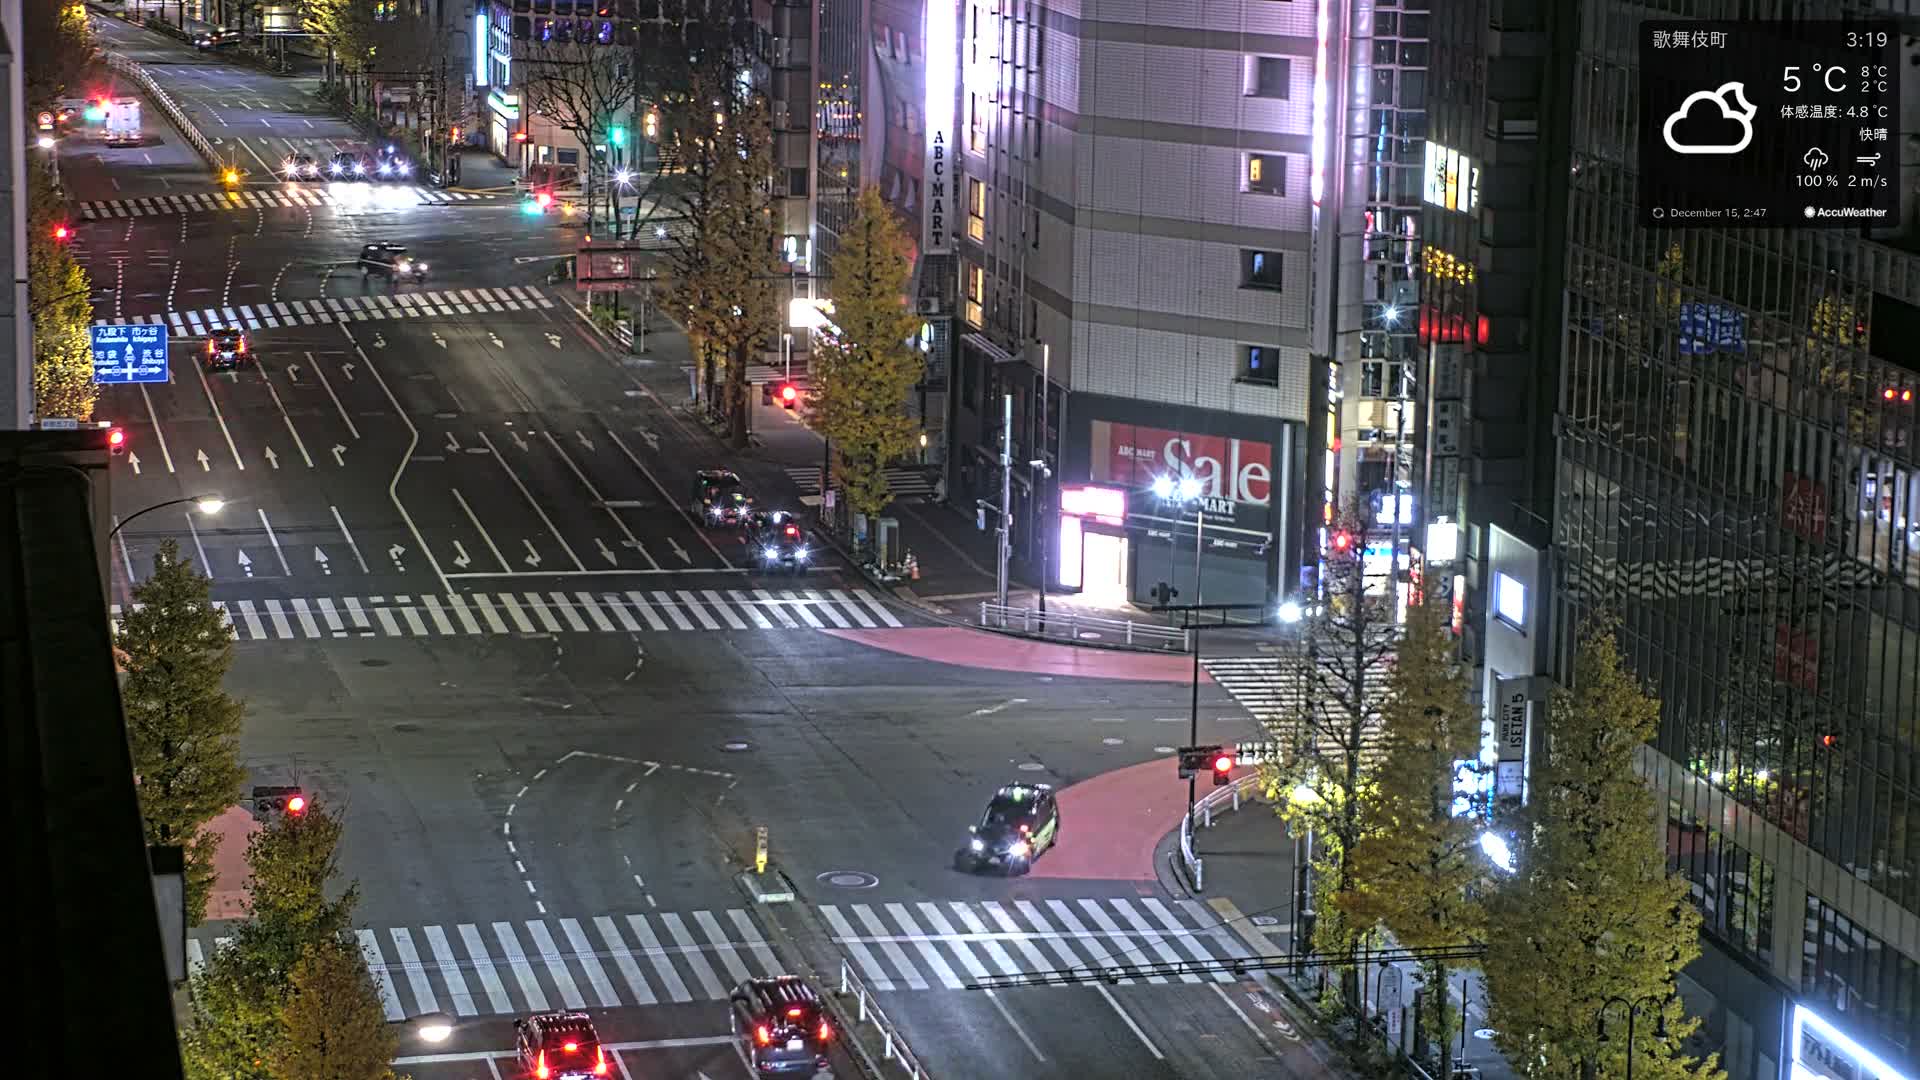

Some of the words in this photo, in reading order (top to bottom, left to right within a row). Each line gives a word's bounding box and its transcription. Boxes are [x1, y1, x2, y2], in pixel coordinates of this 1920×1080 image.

[98, 327, 126, 336] 九段下
[1164, 438, 1271, 507] Sale
[1512, 693, 1524, 703] 5
[1510, 707, 1523, 748] ISETAN
